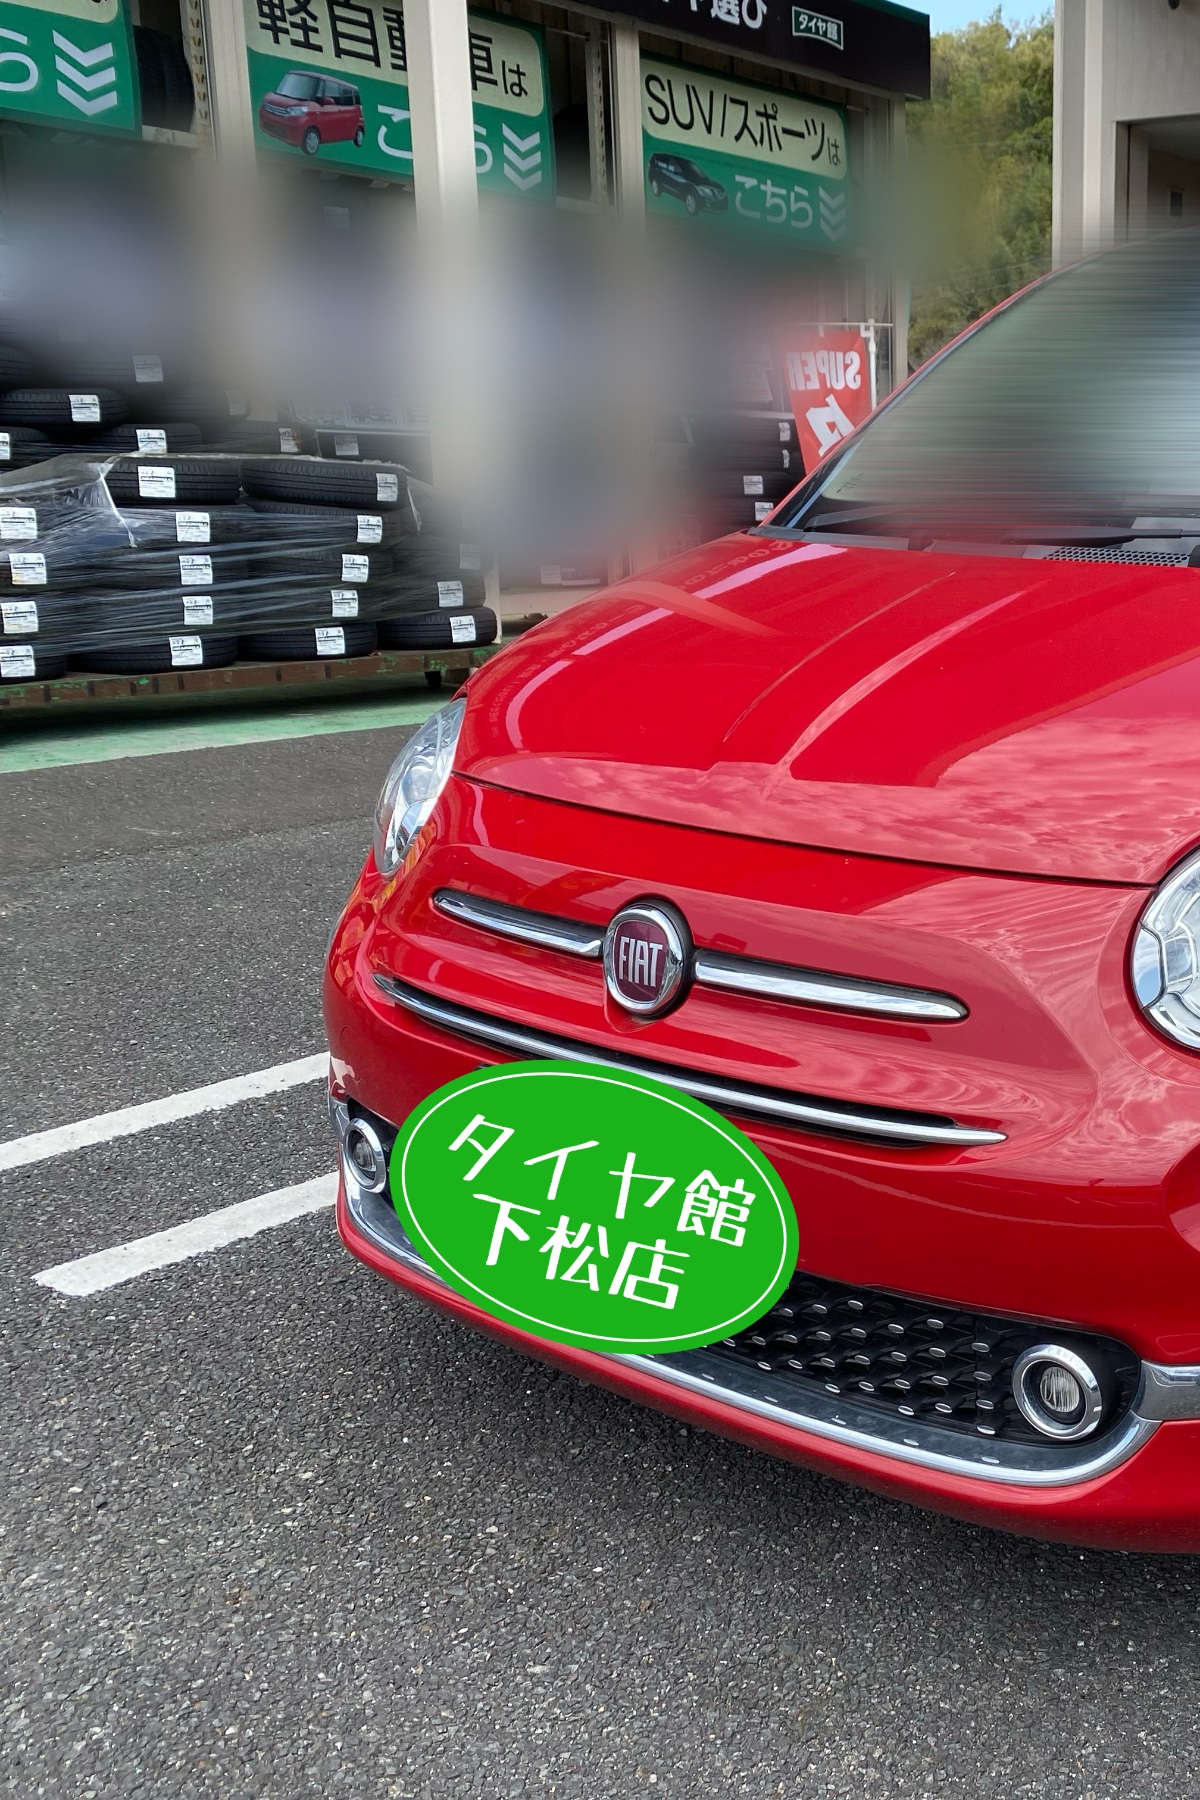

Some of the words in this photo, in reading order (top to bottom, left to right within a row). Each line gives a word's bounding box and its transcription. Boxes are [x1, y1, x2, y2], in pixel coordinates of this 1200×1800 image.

[798, 13, 838, 41] タイヤ館
[377, 103, 494, 175] こら
[644, 73, 842, 167] SUV/スポーツは
[734, 174, 814, 229] こちら
[618, 935, 664, 988] FIAT
